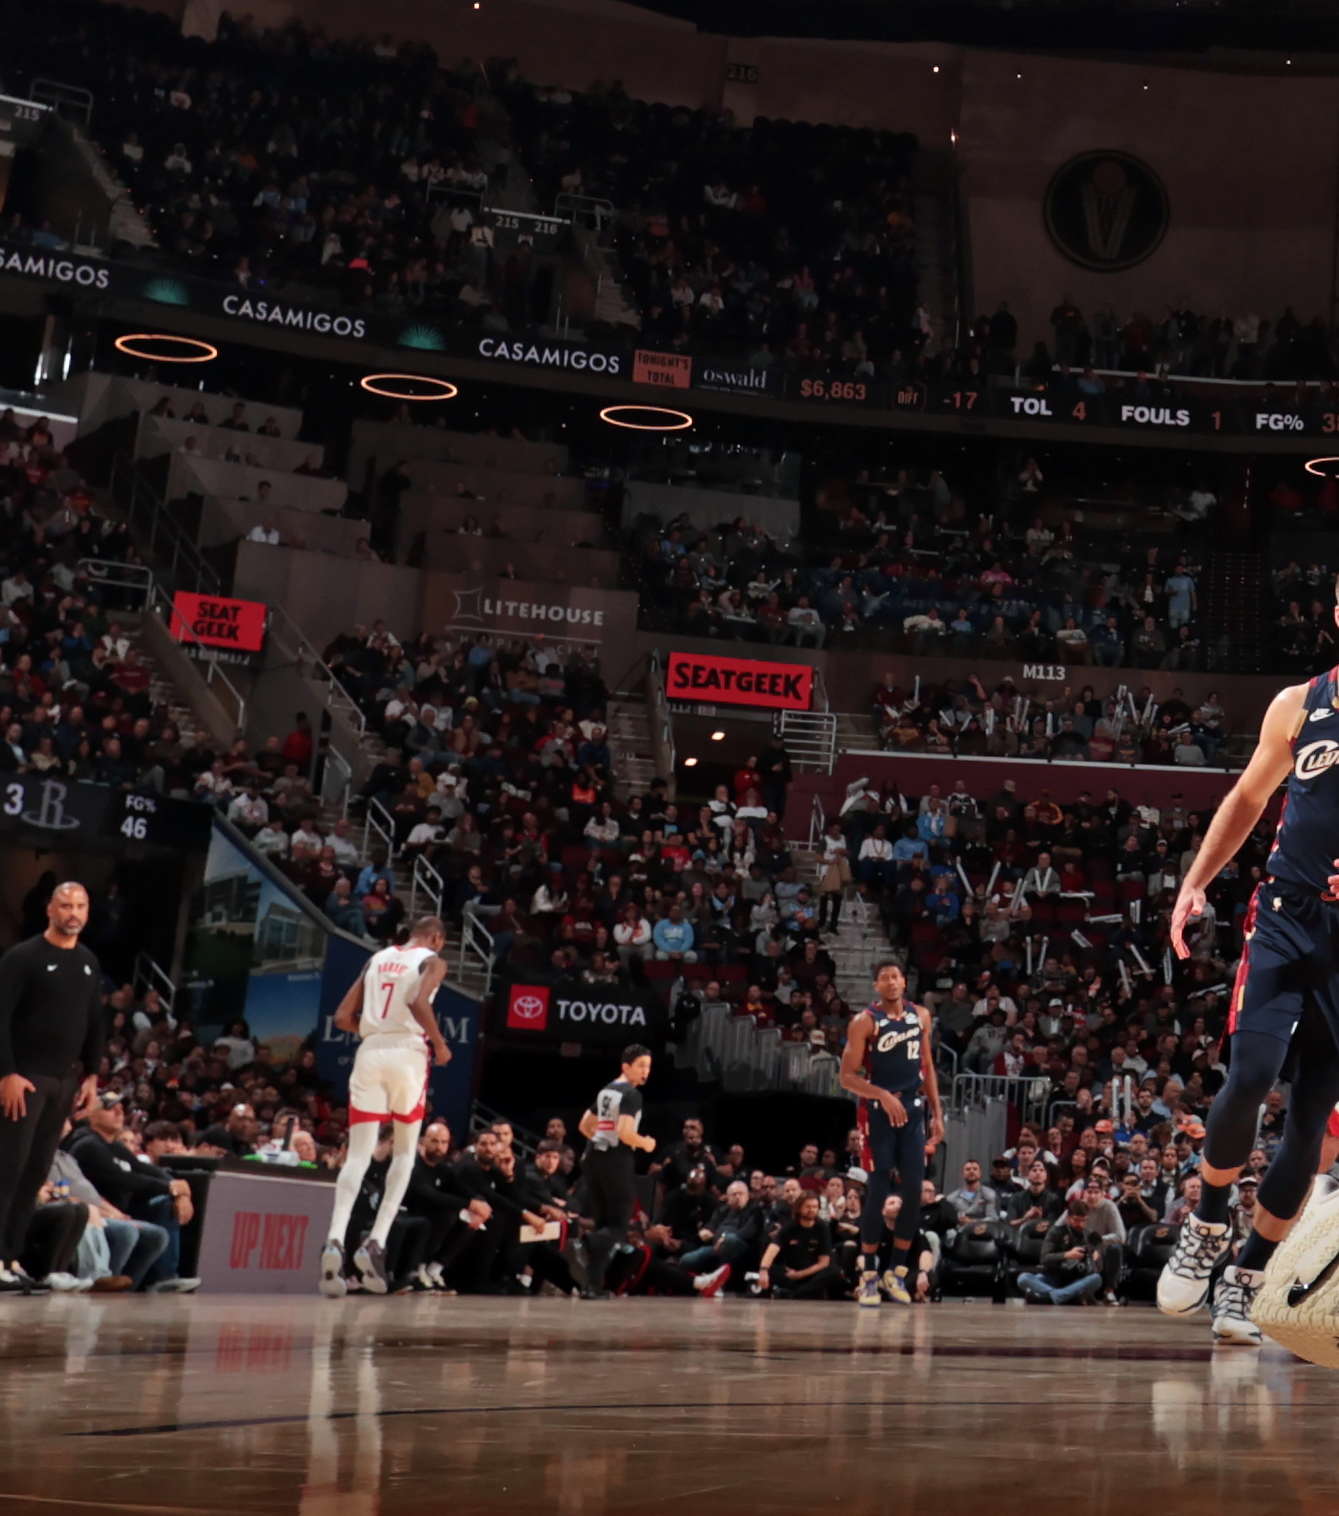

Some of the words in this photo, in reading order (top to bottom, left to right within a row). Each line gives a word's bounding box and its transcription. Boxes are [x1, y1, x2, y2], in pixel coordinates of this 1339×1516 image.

[0, 251, 109, 288] AMIGOS
[223, 295, 365, 338] CASAMIGOS
[479, 338, 620, 374] CASAMIGOS
[704, 368, 767, 390] oswald
[800, 378, 867, 400] $6,863
[1010, 397, 1052, 416] TOL
[1072, 401, 1086, 420] 4
[1121, 405, 1190, 427] FOULS
[1211, 411, 1222, 430] 1
[1255, 413, 1304, 431] FG%
[198, 601, 241, 622] SEAT
[484, 598, 604, 626] LITEHOUSE
[193, 620, 240, 641] GEEK
[674, 662, 803, 701] SEATGEEK
[1022, 664, 1066, 681] M113
[125, 794, 157, 814] FG%
[120, 815, 148, 840] 46
[381, 982, 395, 1019] 7
[556, 999, 646, 1027] TOYOTA
[907, 1041, 920, 1060] 12
[229, 1211, 261, 1269] UP
[258, 1213, 311, 1270] NEXT
